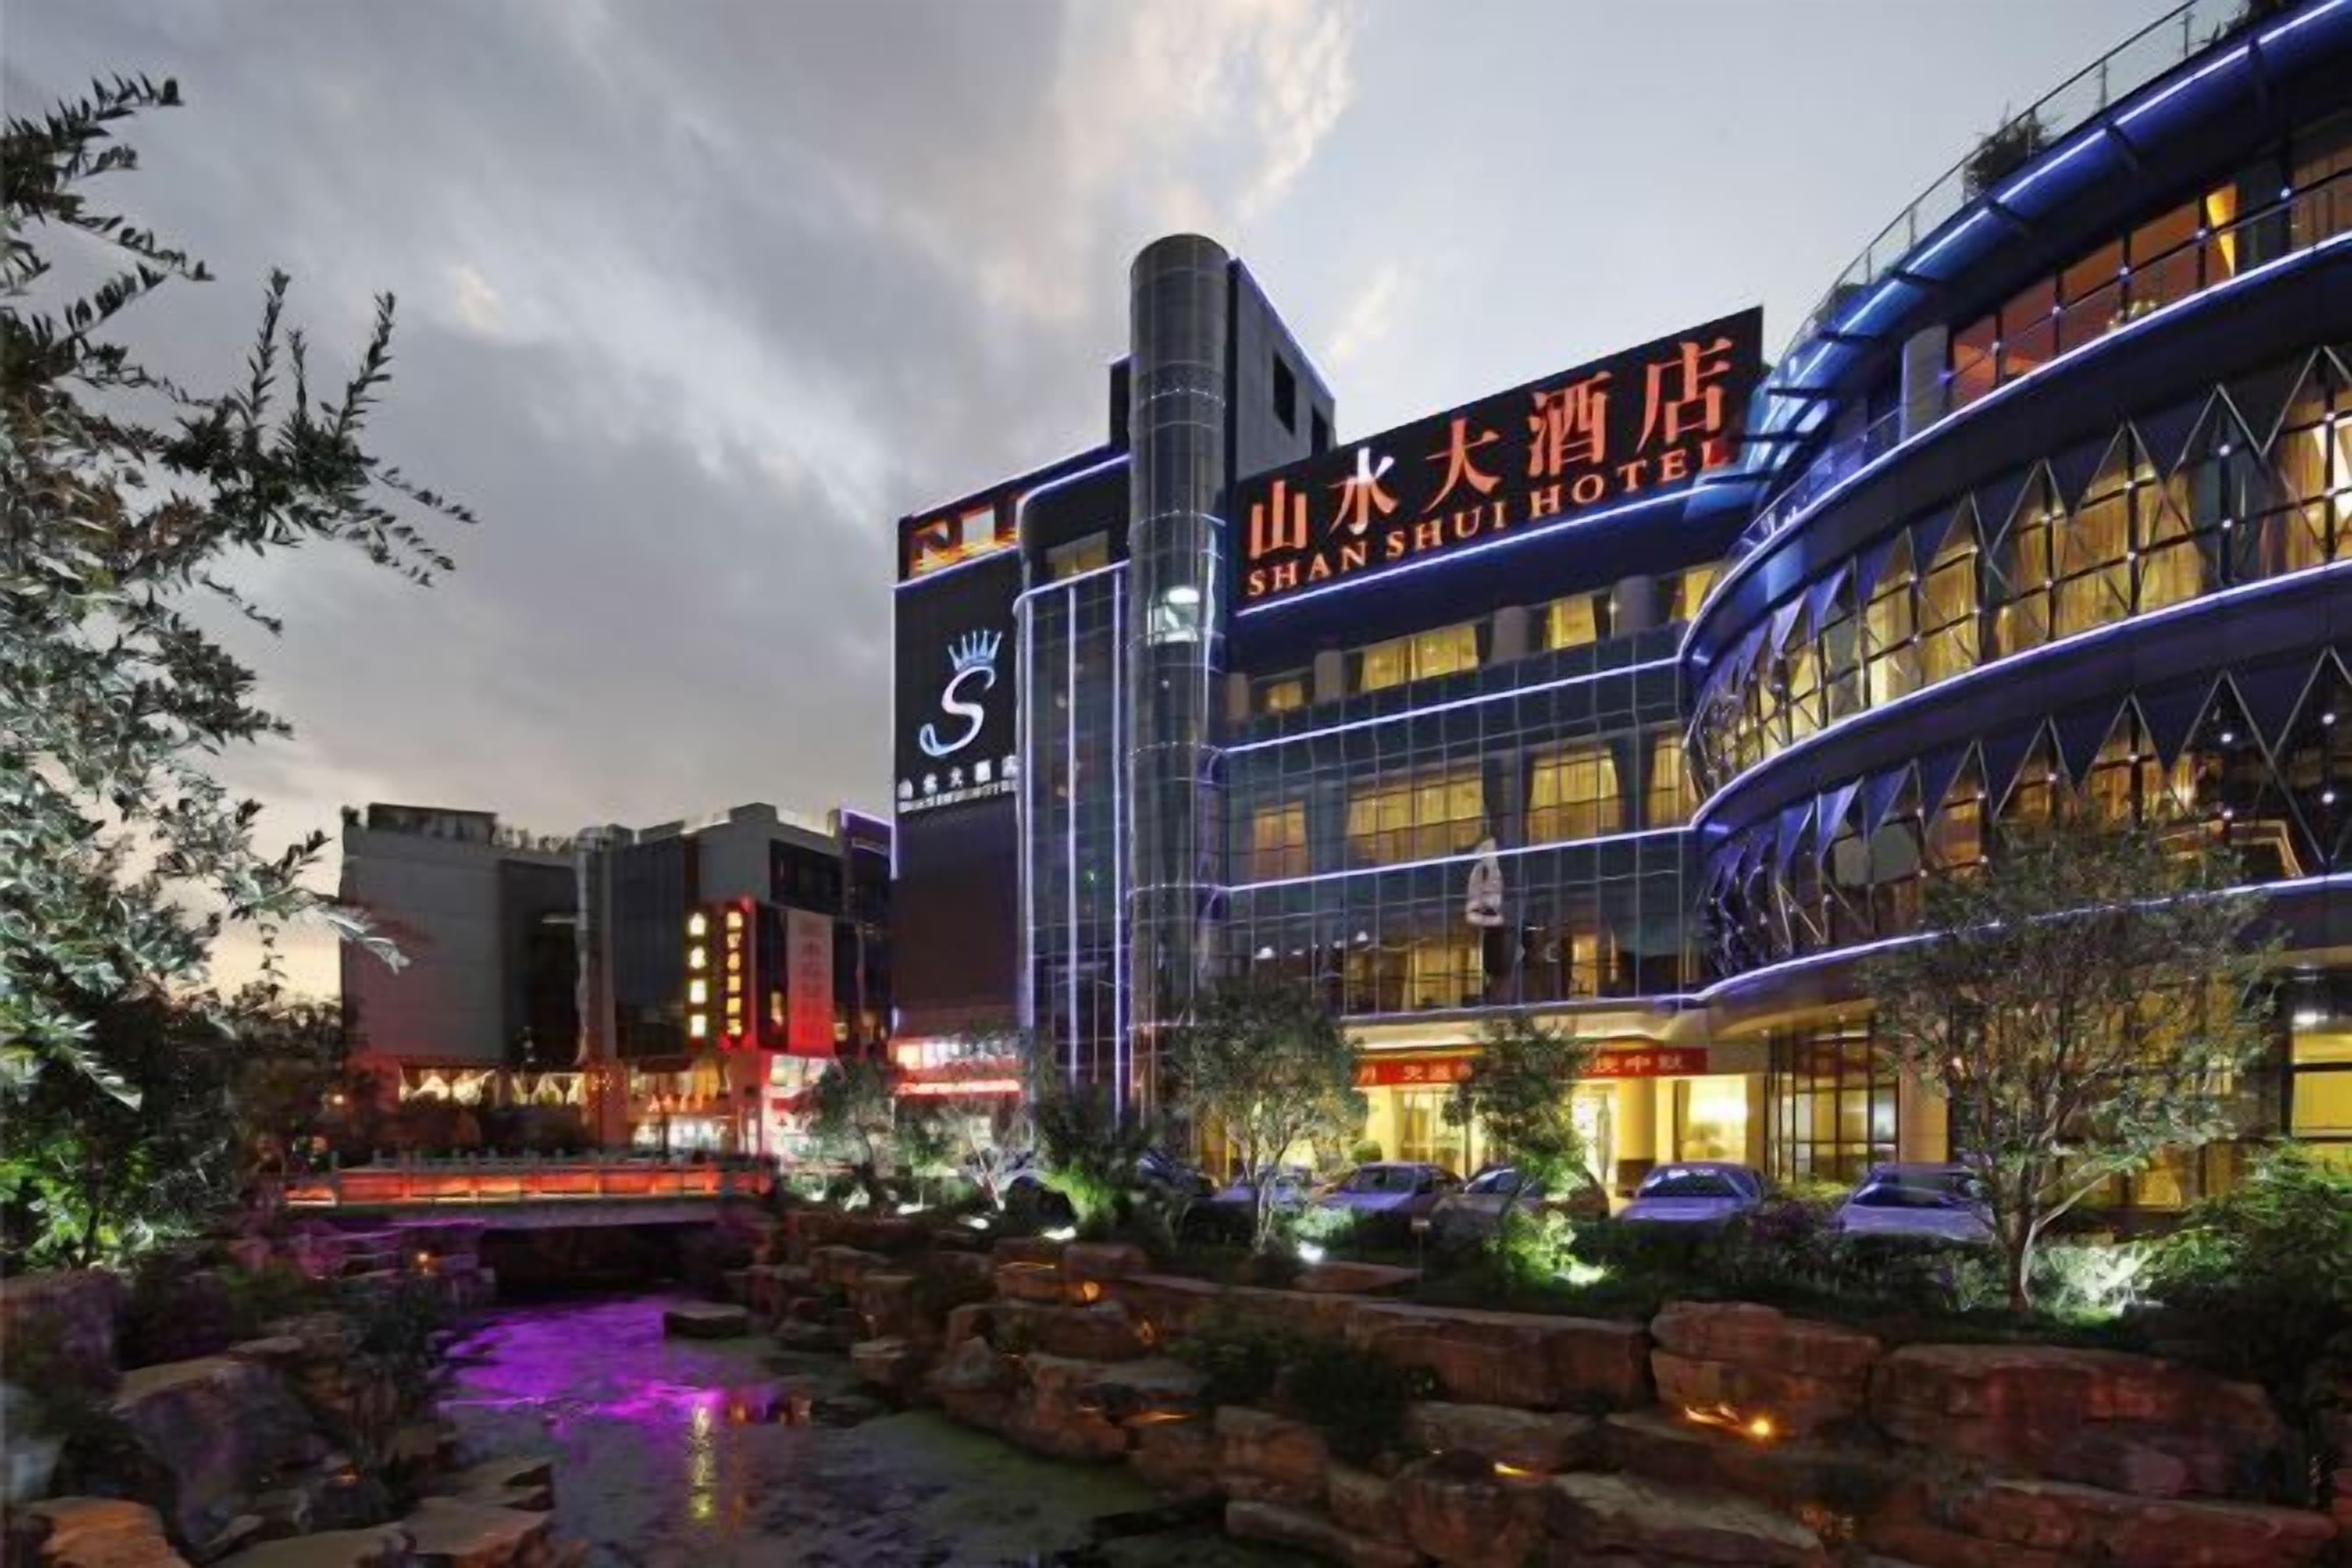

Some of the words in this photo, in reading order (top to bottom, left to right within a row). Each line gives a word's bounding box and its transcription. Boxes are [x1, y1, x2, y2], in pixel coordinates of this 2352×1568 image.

[1249, 541, 1368, 595] SHAN
[1386, 502, 1507, 557] SHUI
[1531, 440, 1730, 519] HOTEL
[1250, 338, 1732, 560] 山水大酒店
[919, 666, 996, 755] S
